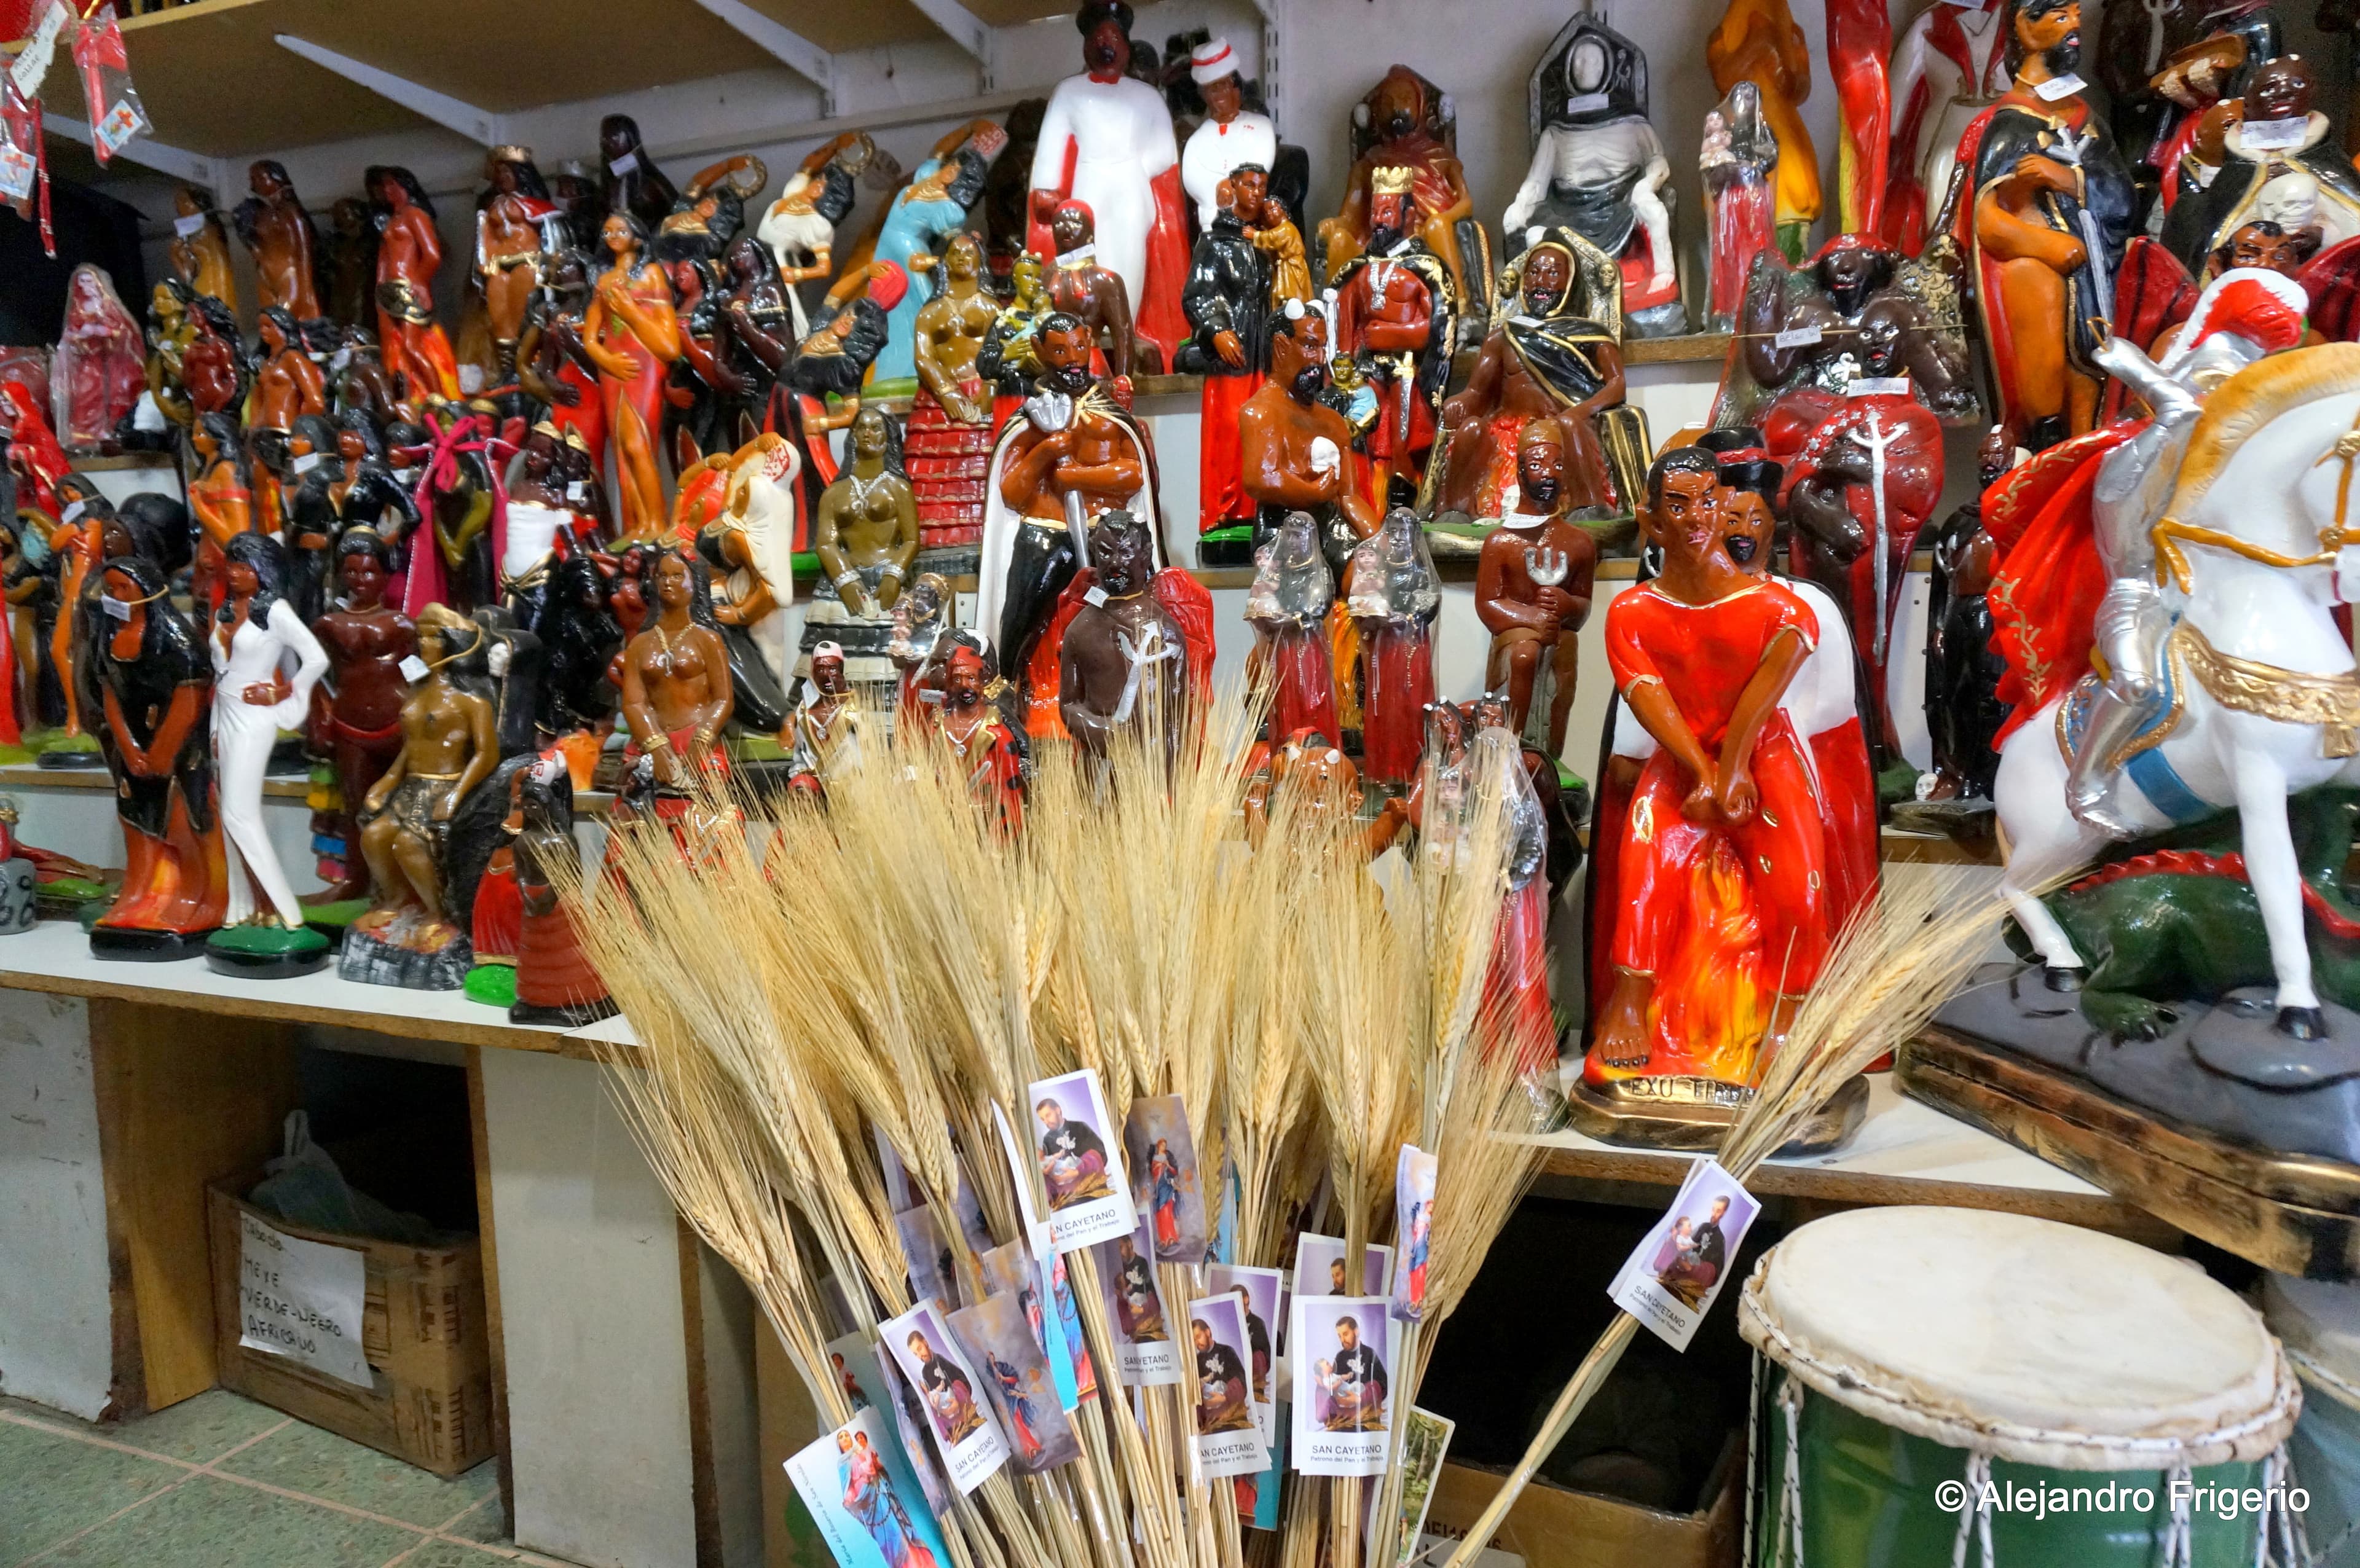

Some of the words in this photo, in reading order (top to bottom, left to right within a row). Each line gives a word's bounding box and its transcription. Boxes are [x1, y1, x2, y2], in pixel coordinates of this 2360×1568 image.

[1630, 1077, 1674, 1097] EXU
[1064, 1209, 1115, 1230] CAYETANO
[1211, 1442, 1254, 1456] CAYETANO
[1312, 1445, 1332, 1454] SAN
[1335, 1445, 1382, 1454] CAYETANO
